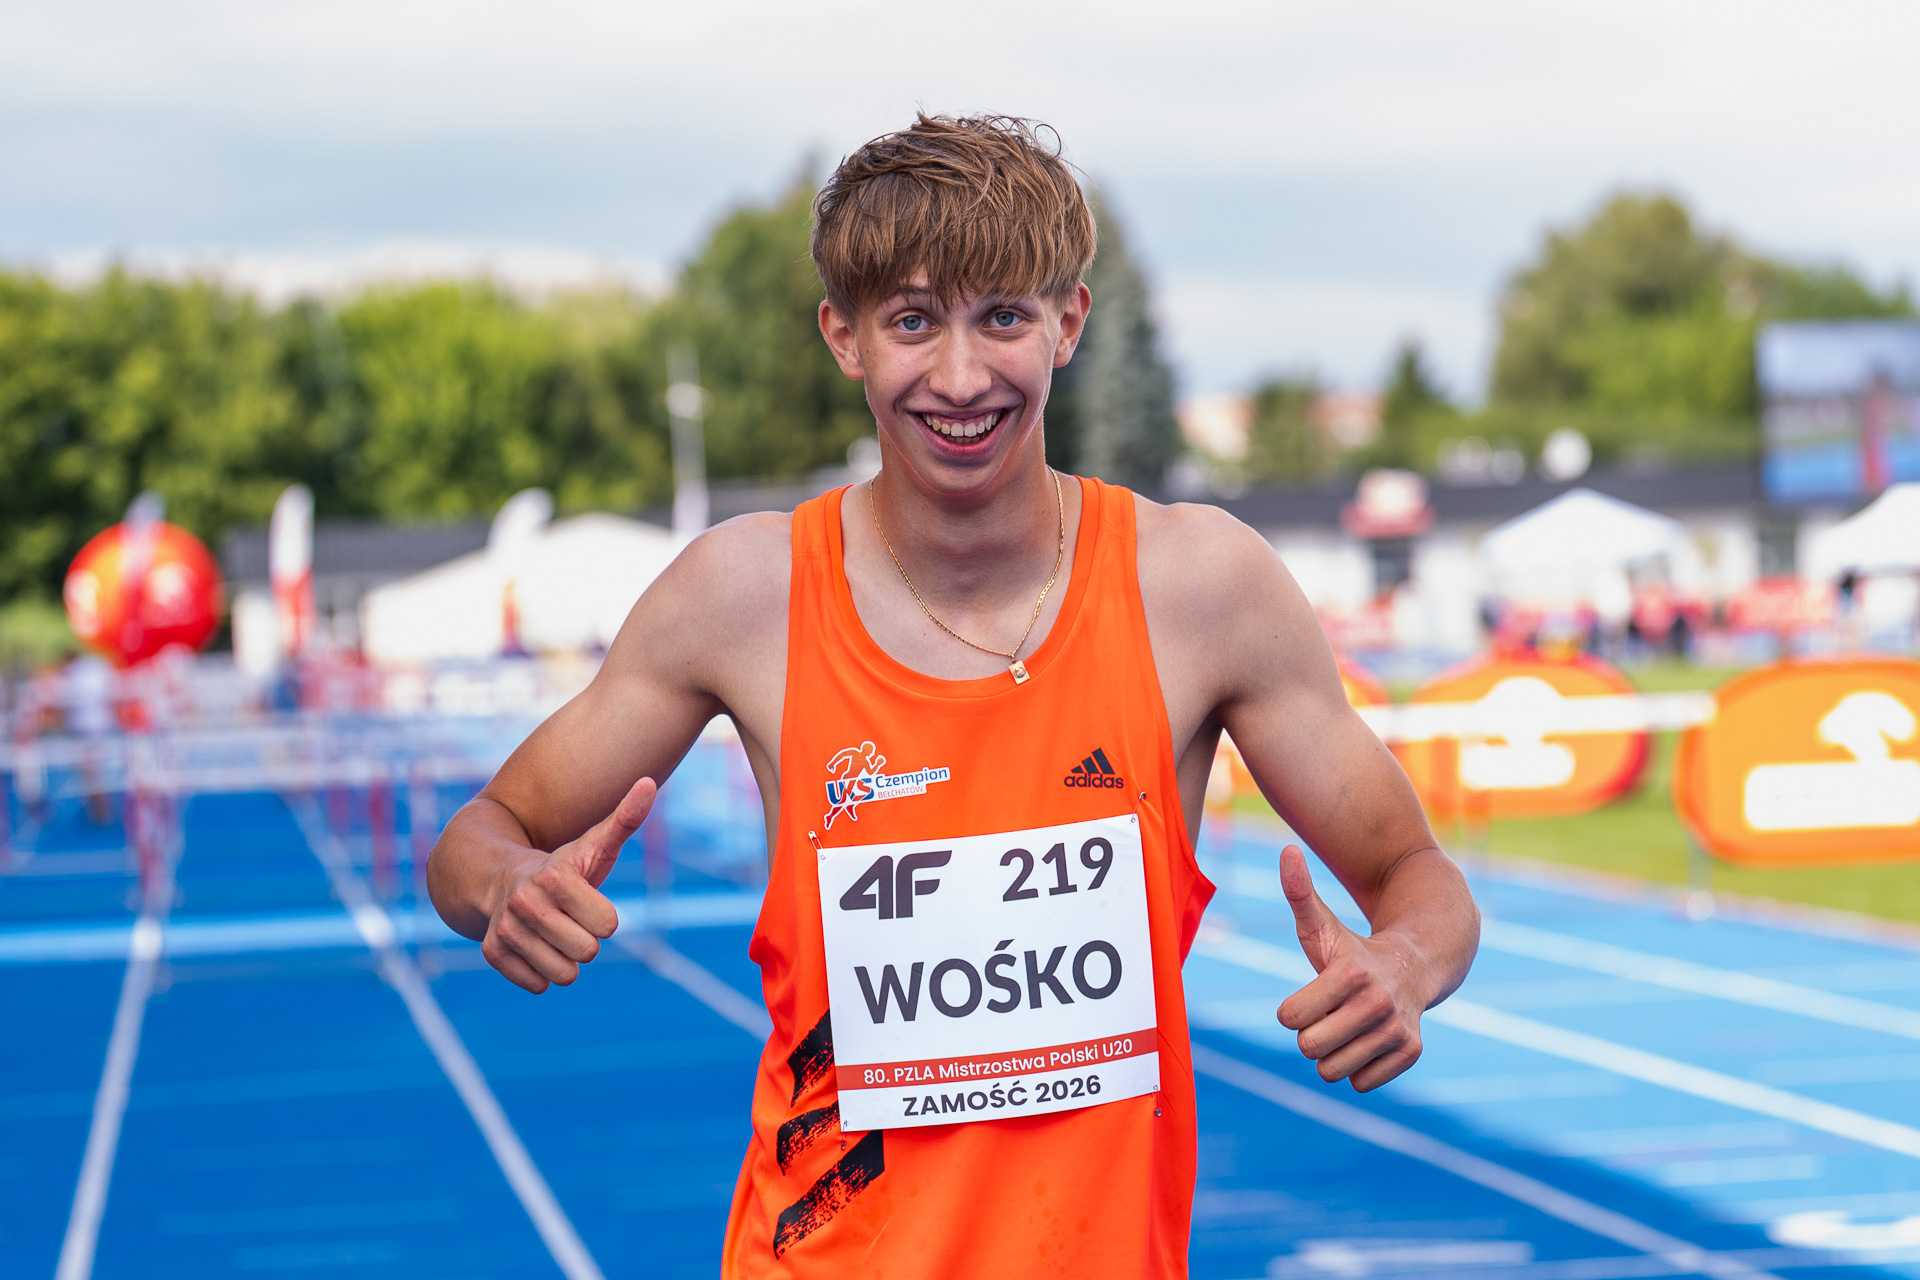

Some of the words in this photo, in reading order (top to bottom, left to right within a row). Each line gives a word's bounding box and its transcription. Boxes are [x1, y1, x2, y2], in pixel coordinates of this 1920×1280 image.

[827, 778, 875, 804] UKS
[876, 769, 948, 788] Czempion
[878, 786, 924, 799] BEŁCHATÓW
[1064, 773, 1124, 788] adidas
[839, 850, 952, 920] 4F
[999, 837, 1114, 902] 219
[854, 939, 1122, 1024] WOŚKO
[864, 1069, 890, 1085] 80.
[894, 1067, 934, 1082] PZLA
[939, 1055, 1045, 1079] Mistrzostwa
[1050, 1044, 1098, 1066] Polski
[1102, 1038, 1133, 1057] U20
[902, 1080, 1028, 1117] ZAMOŚĆ
[1035, 1074, 1101, 1103] 2026
